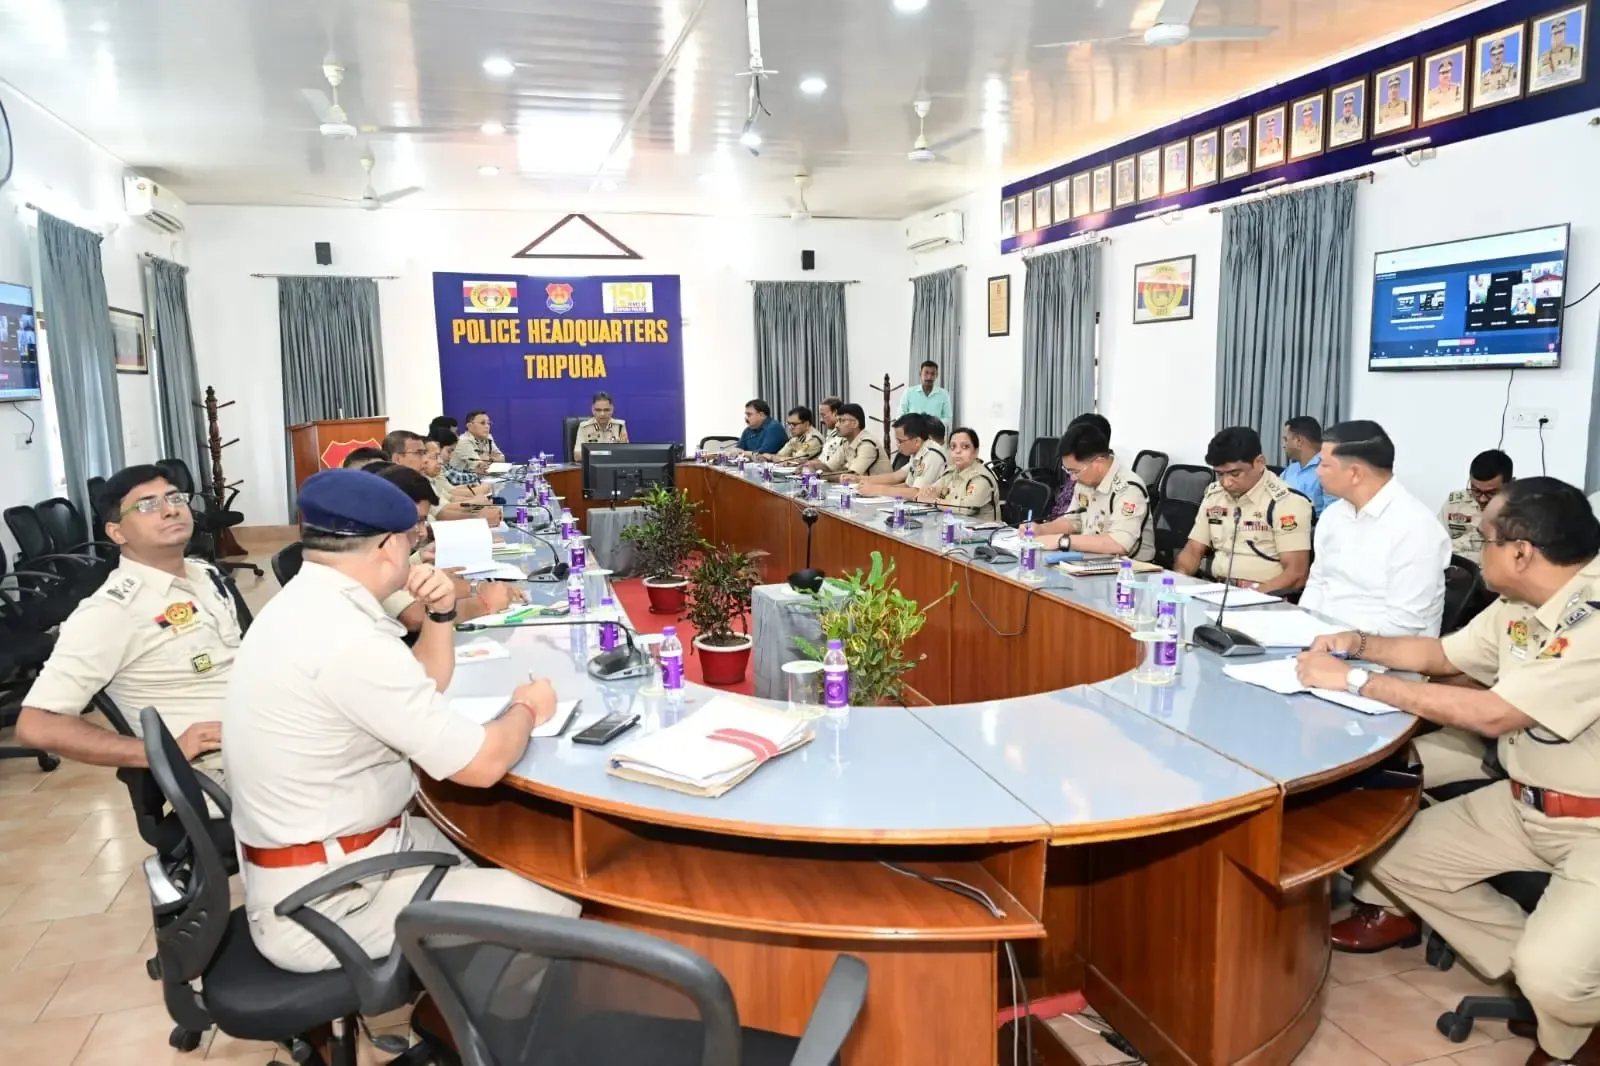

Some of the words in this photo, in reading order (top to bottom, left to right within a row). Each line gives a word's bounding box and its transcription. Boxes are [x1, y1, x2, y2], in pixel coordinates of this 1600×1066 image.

[608, 283, 646, 306] 150
[453, 319, 520, 344] POLICE
[528, 319, 668, 346] HEADQUARTERS
[524, 354, 606, 379] TRIPURA
